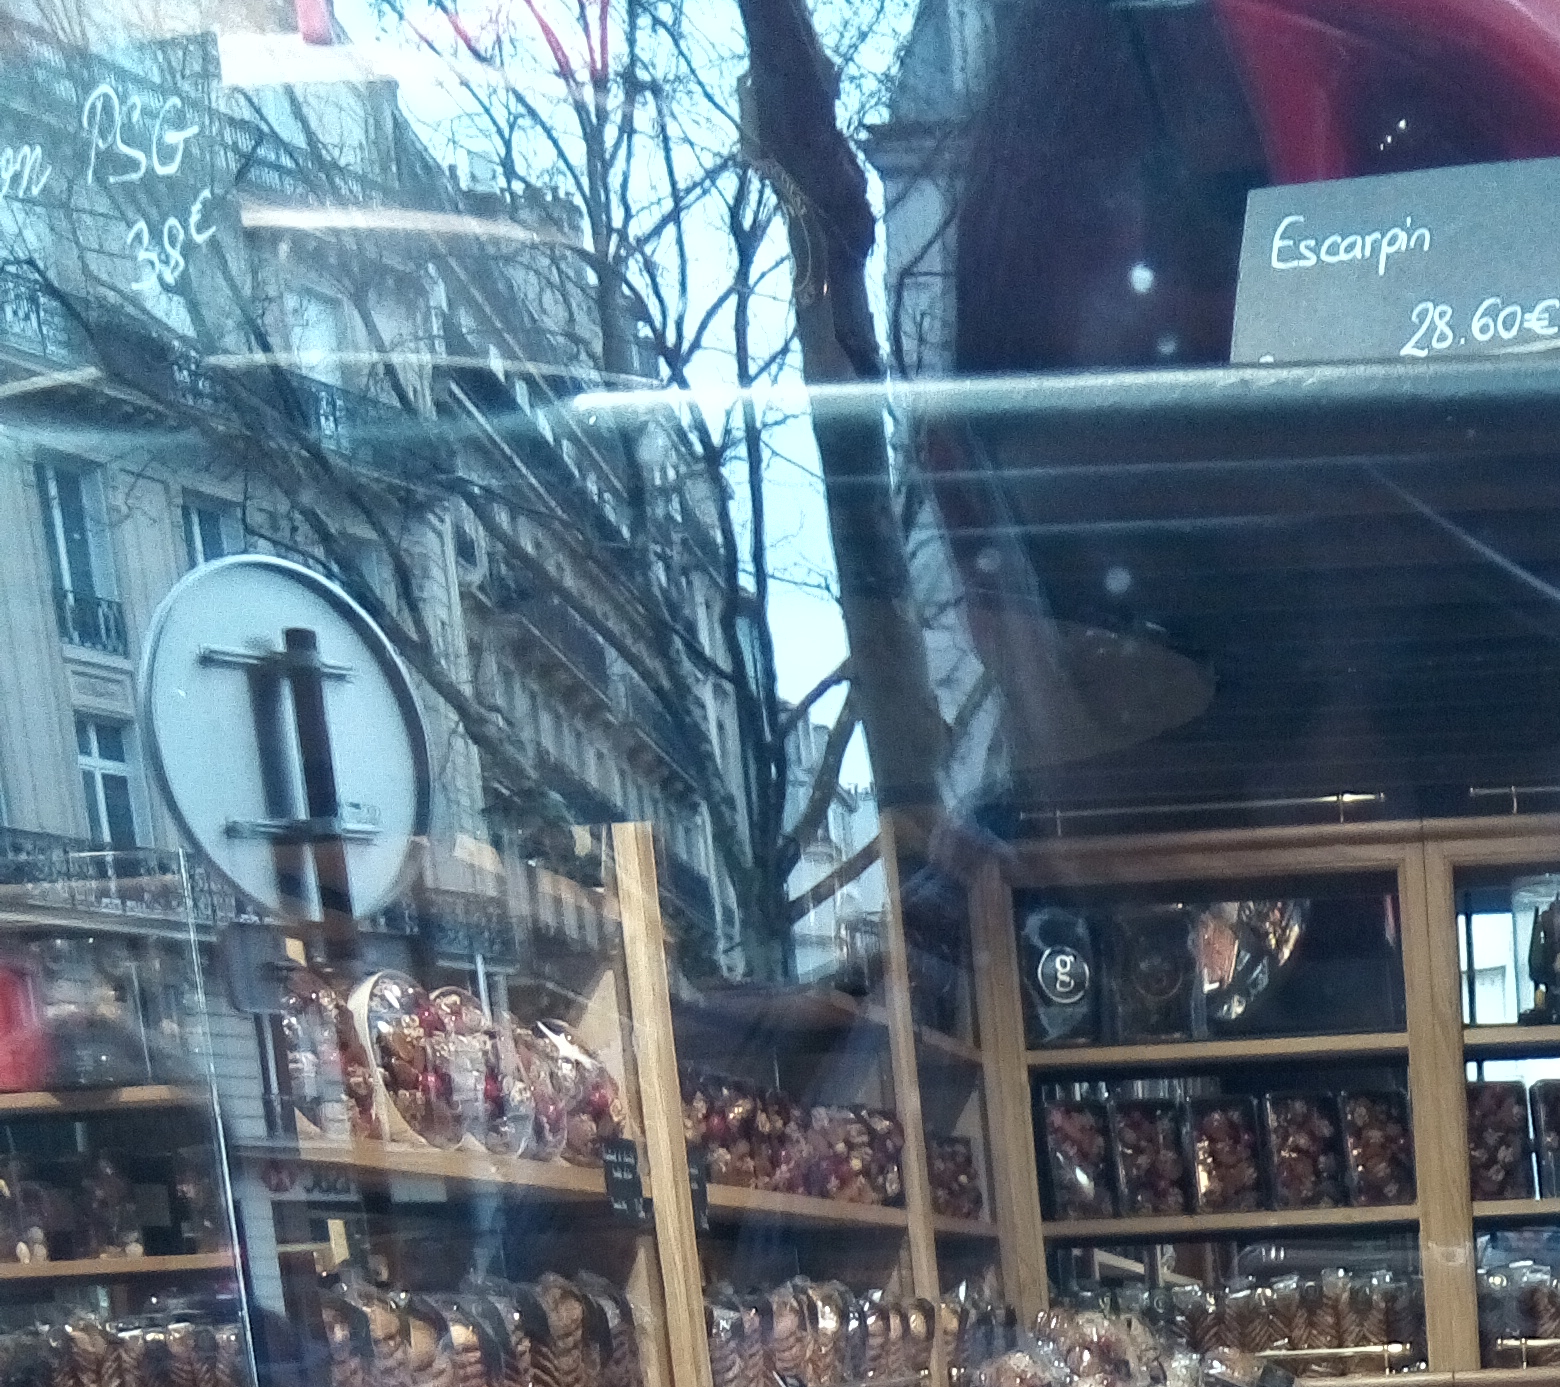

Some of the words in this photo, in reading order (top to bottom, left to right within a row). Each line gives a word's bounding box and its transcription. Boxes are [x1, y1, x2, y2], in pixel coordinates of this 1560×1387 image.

[82, 84, 200, 184] PSG
[1271, 214, 1432, 277] Escarpin
[1399, 296, 1560, 358] 28.60€
